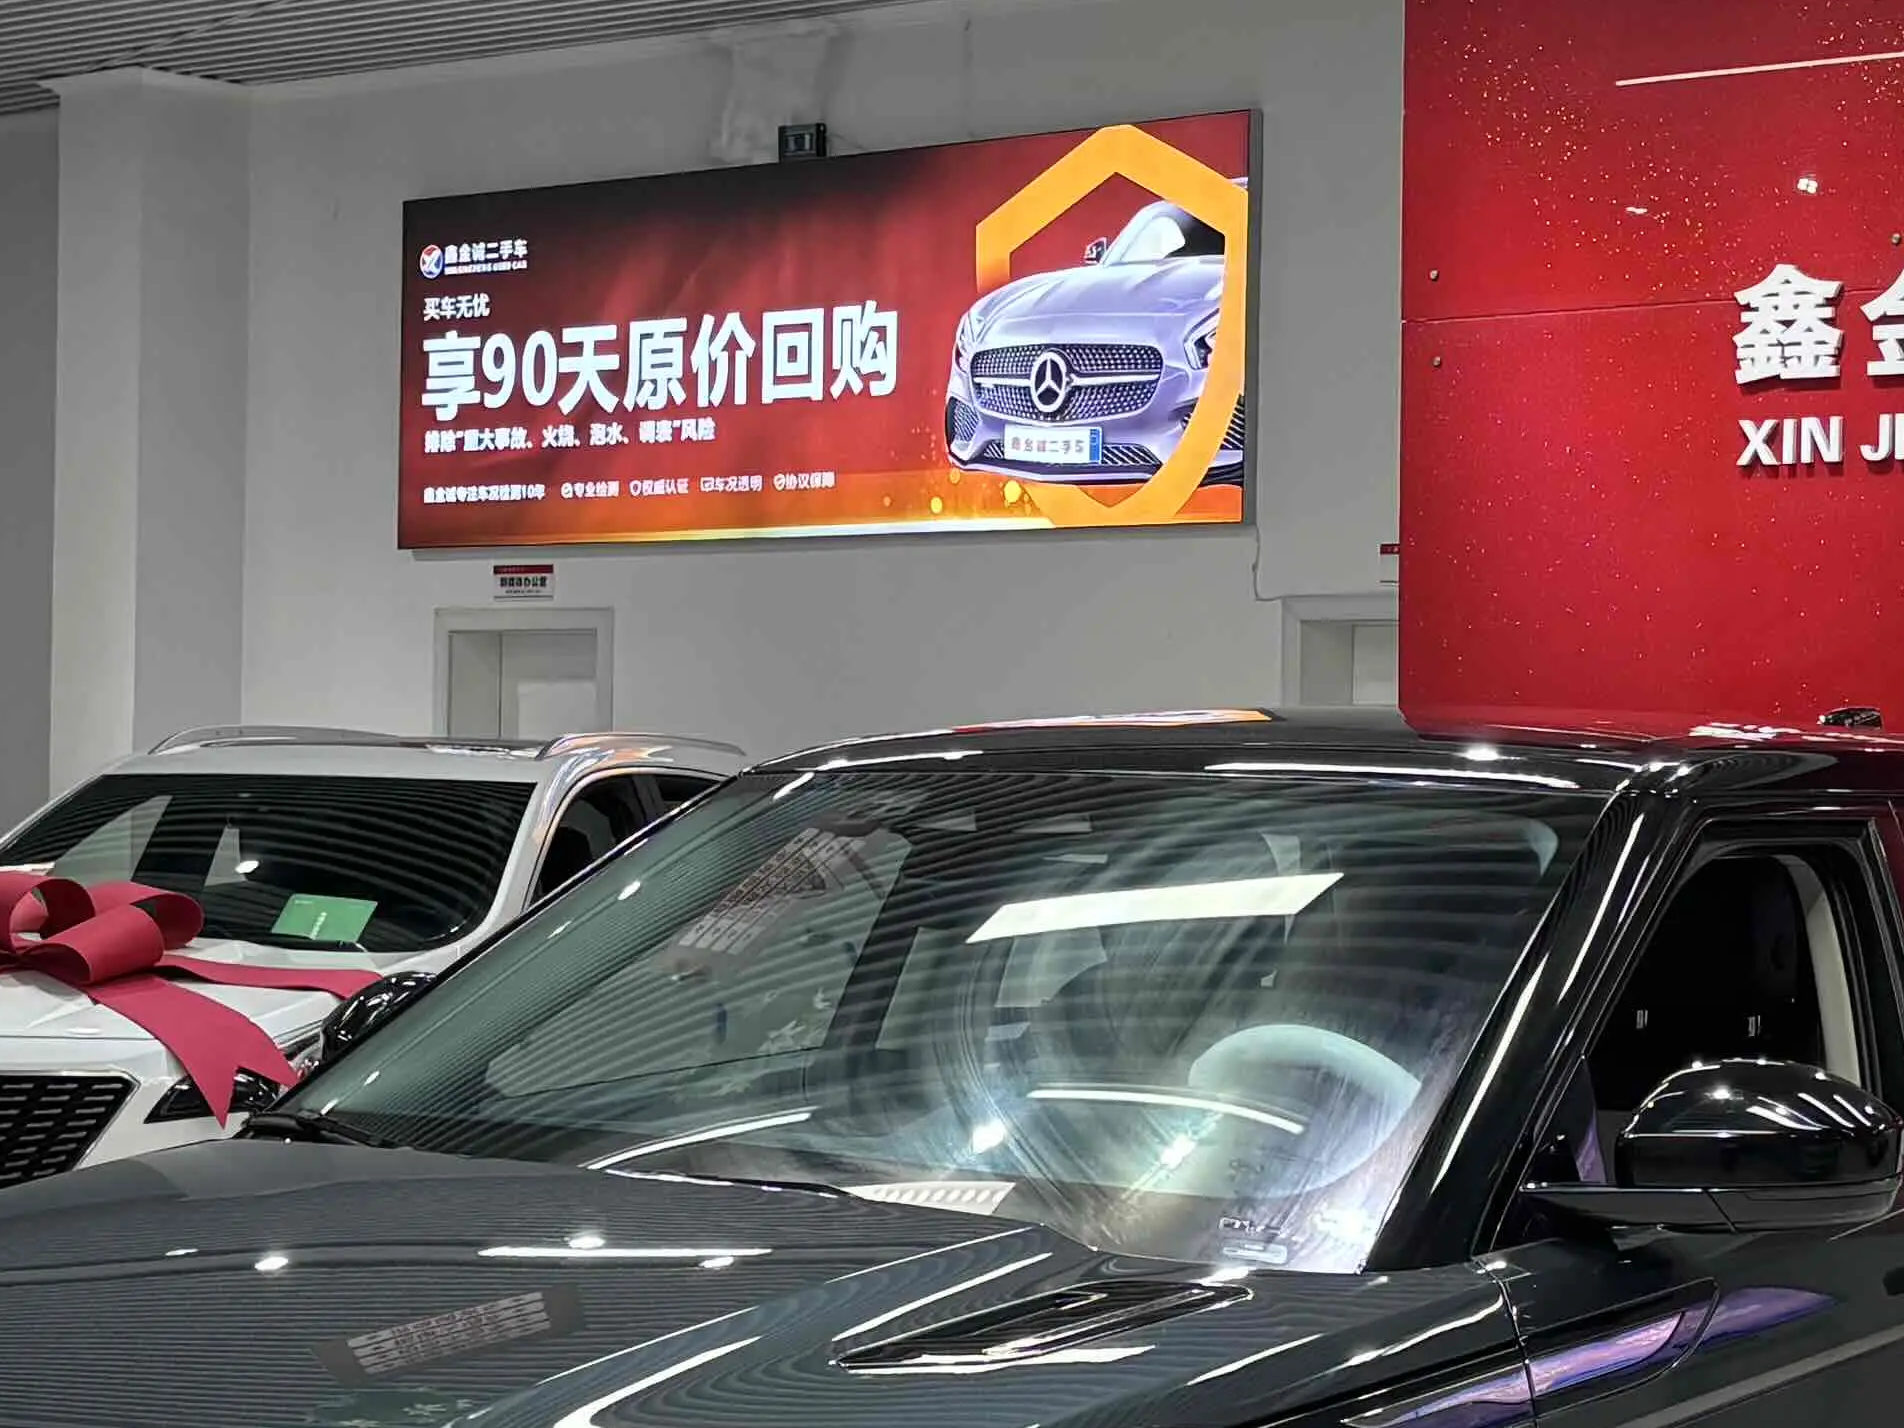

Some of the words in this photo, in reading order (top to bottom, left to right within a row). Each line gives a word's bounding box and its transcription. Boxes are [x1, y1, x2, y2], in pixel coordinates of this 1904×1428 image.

[423, 293, 490, 322] 买车无忧
[422, 299, 898, 422] 享90天原价回购
[1737, 415, 1844, 470] XIN
